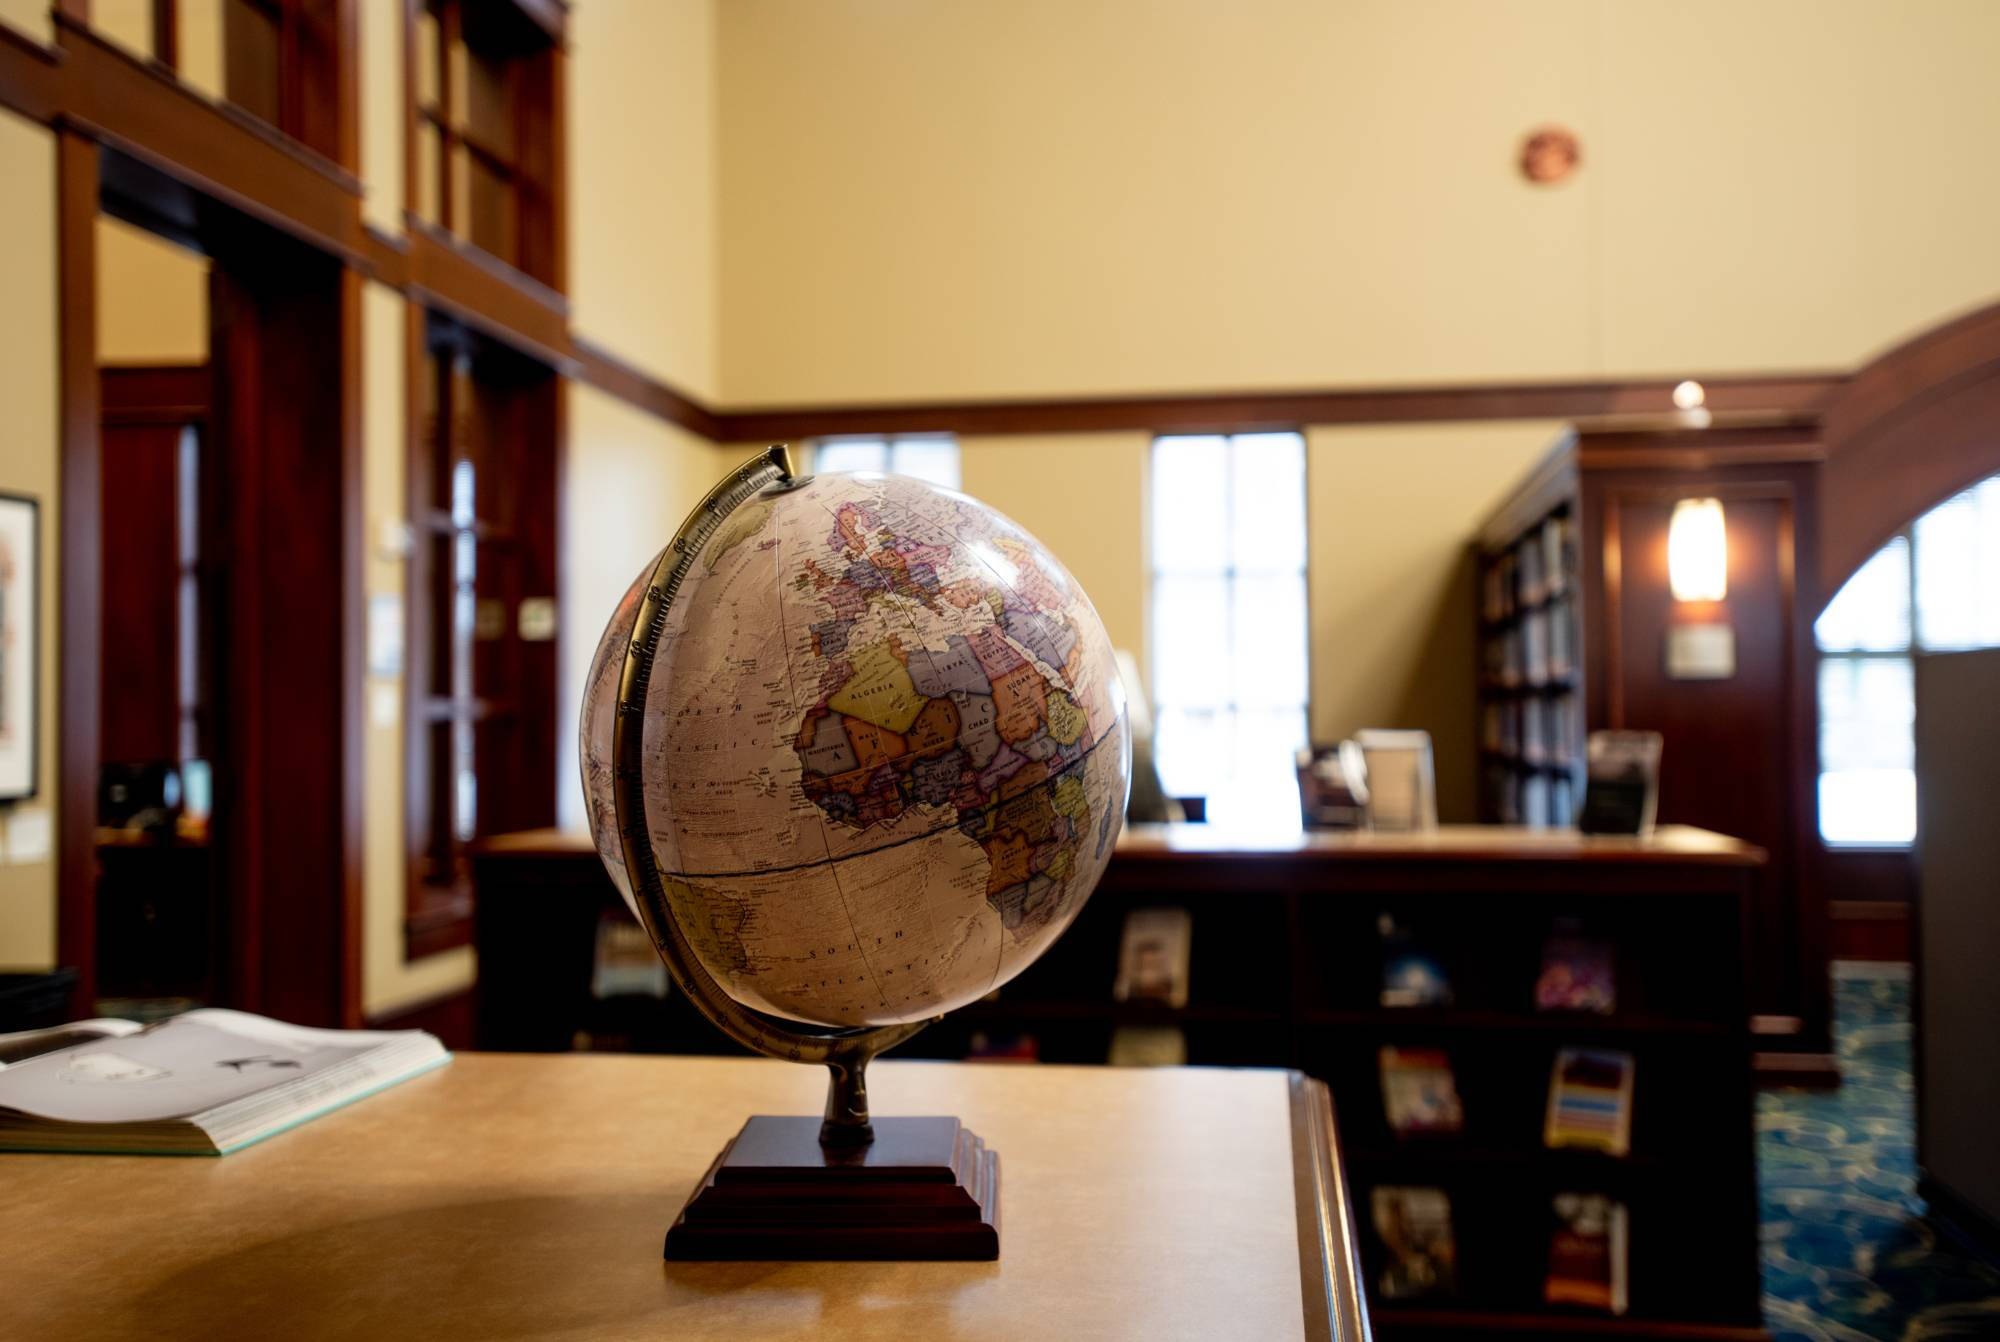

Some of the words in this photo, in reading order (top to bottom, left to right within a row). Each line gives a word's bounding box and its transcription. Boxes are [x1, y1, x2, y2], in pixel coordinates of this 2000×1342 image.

[673, 536, 687, 554] 60
[647, 584, 660, 603] 50
[630, 639, 641, 659] 40
[982, 646, 1004, 661] EGYPT
[936, 659, 964, 675] LIBYA
[850, 682, 895, 700] ALGERIA
[1006, 674, 1032, 692] SUDAN
[968, 718, 989, 731] CHAD
[858, 732, 879, 742] MALI
[922, 736, 946, 748] NIGER
[807, 742, 846, 756] MAURITANIA
